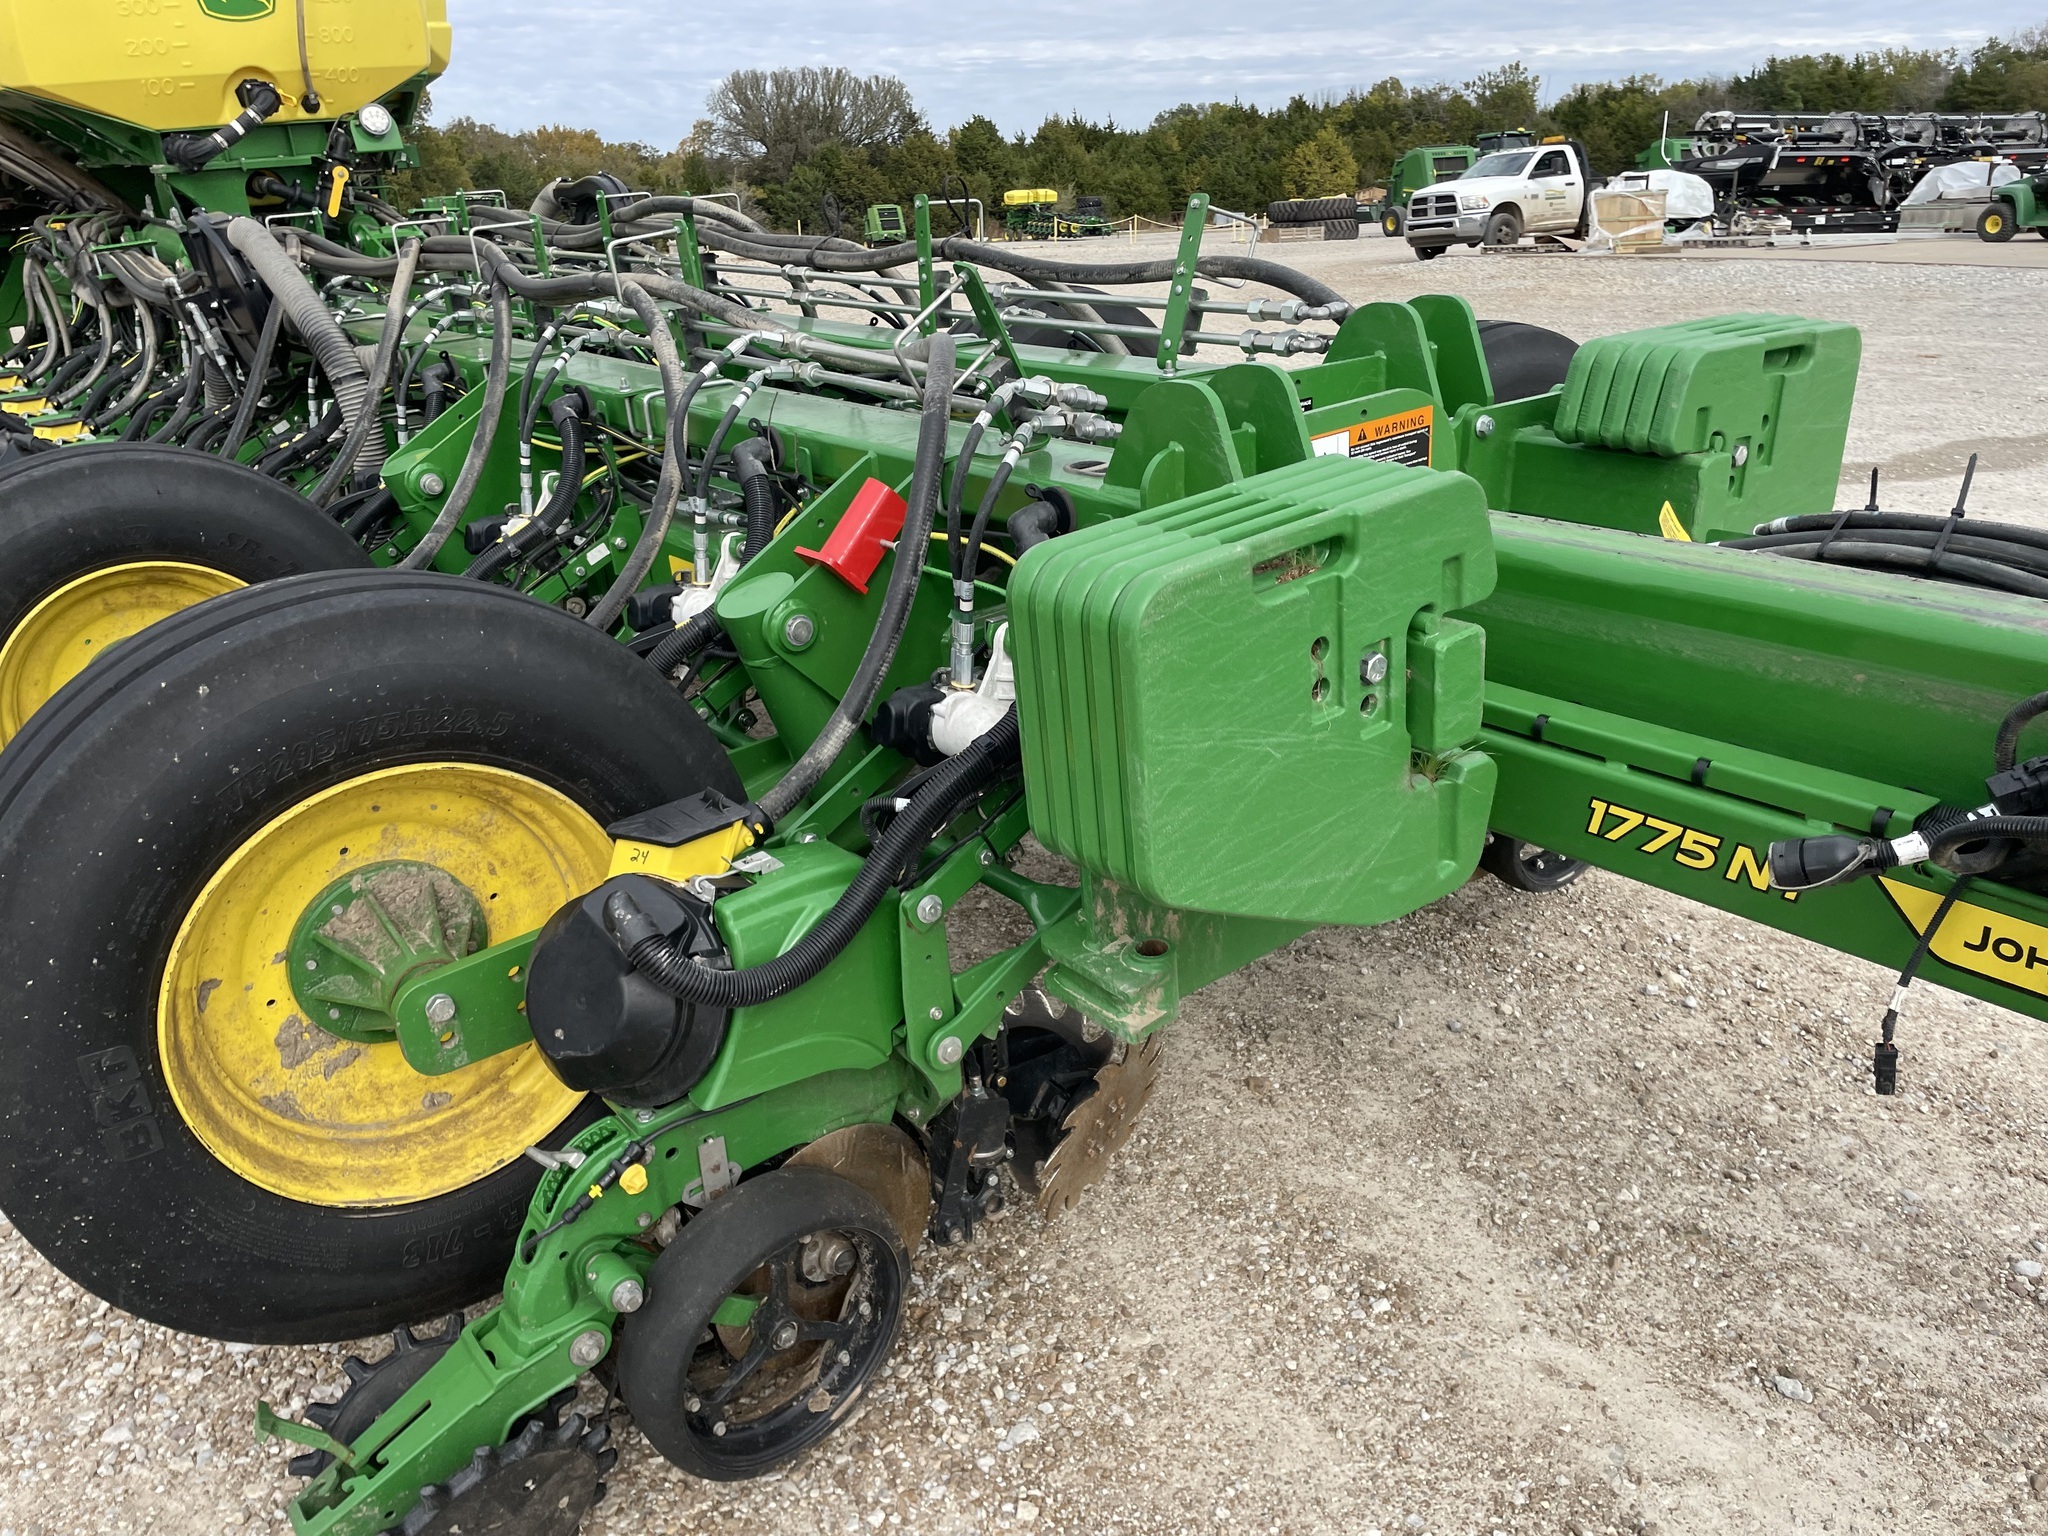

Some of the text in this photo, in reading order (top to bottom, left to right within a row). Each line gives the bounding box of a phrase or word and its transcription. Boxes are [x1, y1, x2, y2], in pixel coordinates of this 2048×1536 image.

[116, 0, 160, 16] 300
[319, 26, 354, 44] 800
[124, 37, 168, 57] 200
[325, 66, 360, 83] 400
[141, 77, 174, 97] 100
[1374, 414, 1426, 438] WARNING
[629, 847, 650, 865] 24
[1585, 796, 1802, 903] 1775 N
